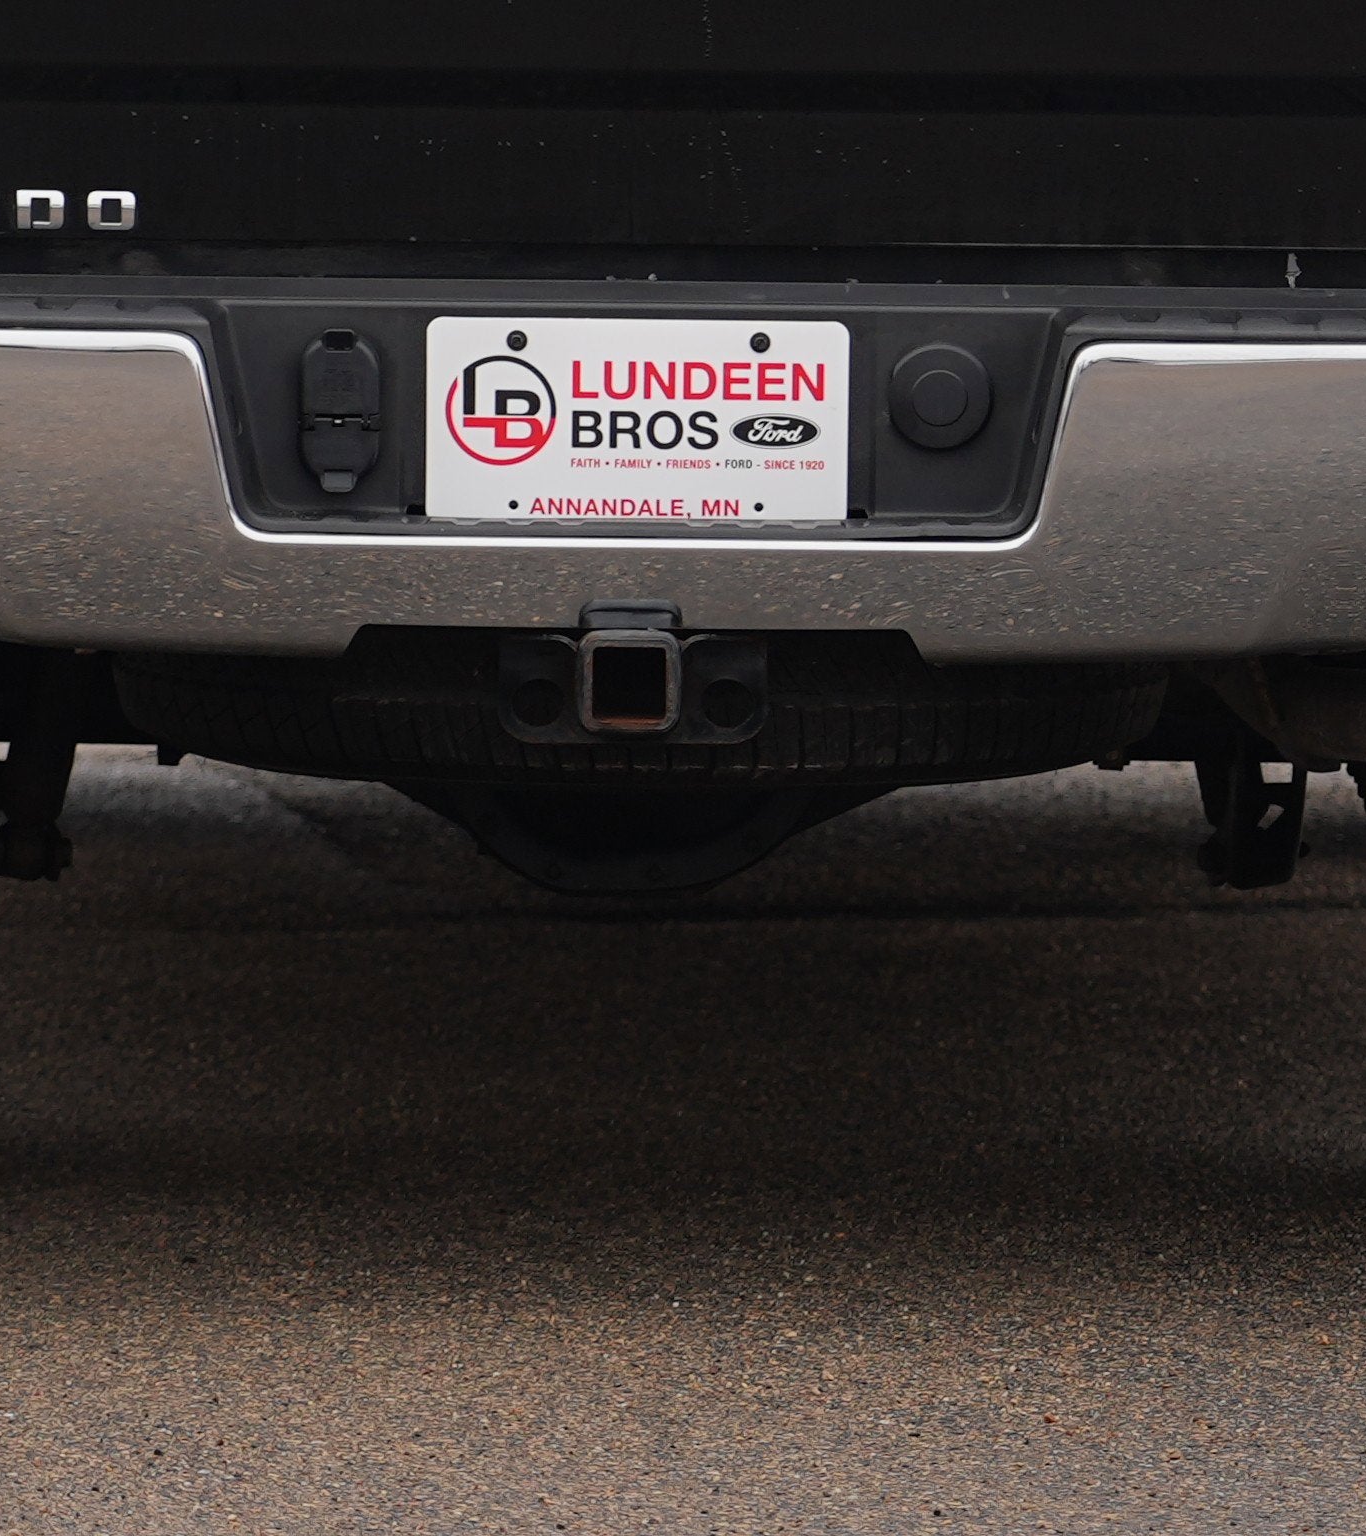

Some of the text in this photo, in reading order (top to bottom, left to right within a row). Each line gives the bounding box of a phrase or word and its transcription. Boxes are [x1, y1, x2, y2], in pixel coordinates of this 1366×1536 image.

[571, 361, 824, 401] LUNDEEN
[571, 411, 719, 450] BROS
[747, 418, 803, 443] Ford
[570, 458, 825, 470] FAITH FAMILY FRIENDS FORD SINCE 1920
[530, 498, 740, 518] ANNANDALE, MN
